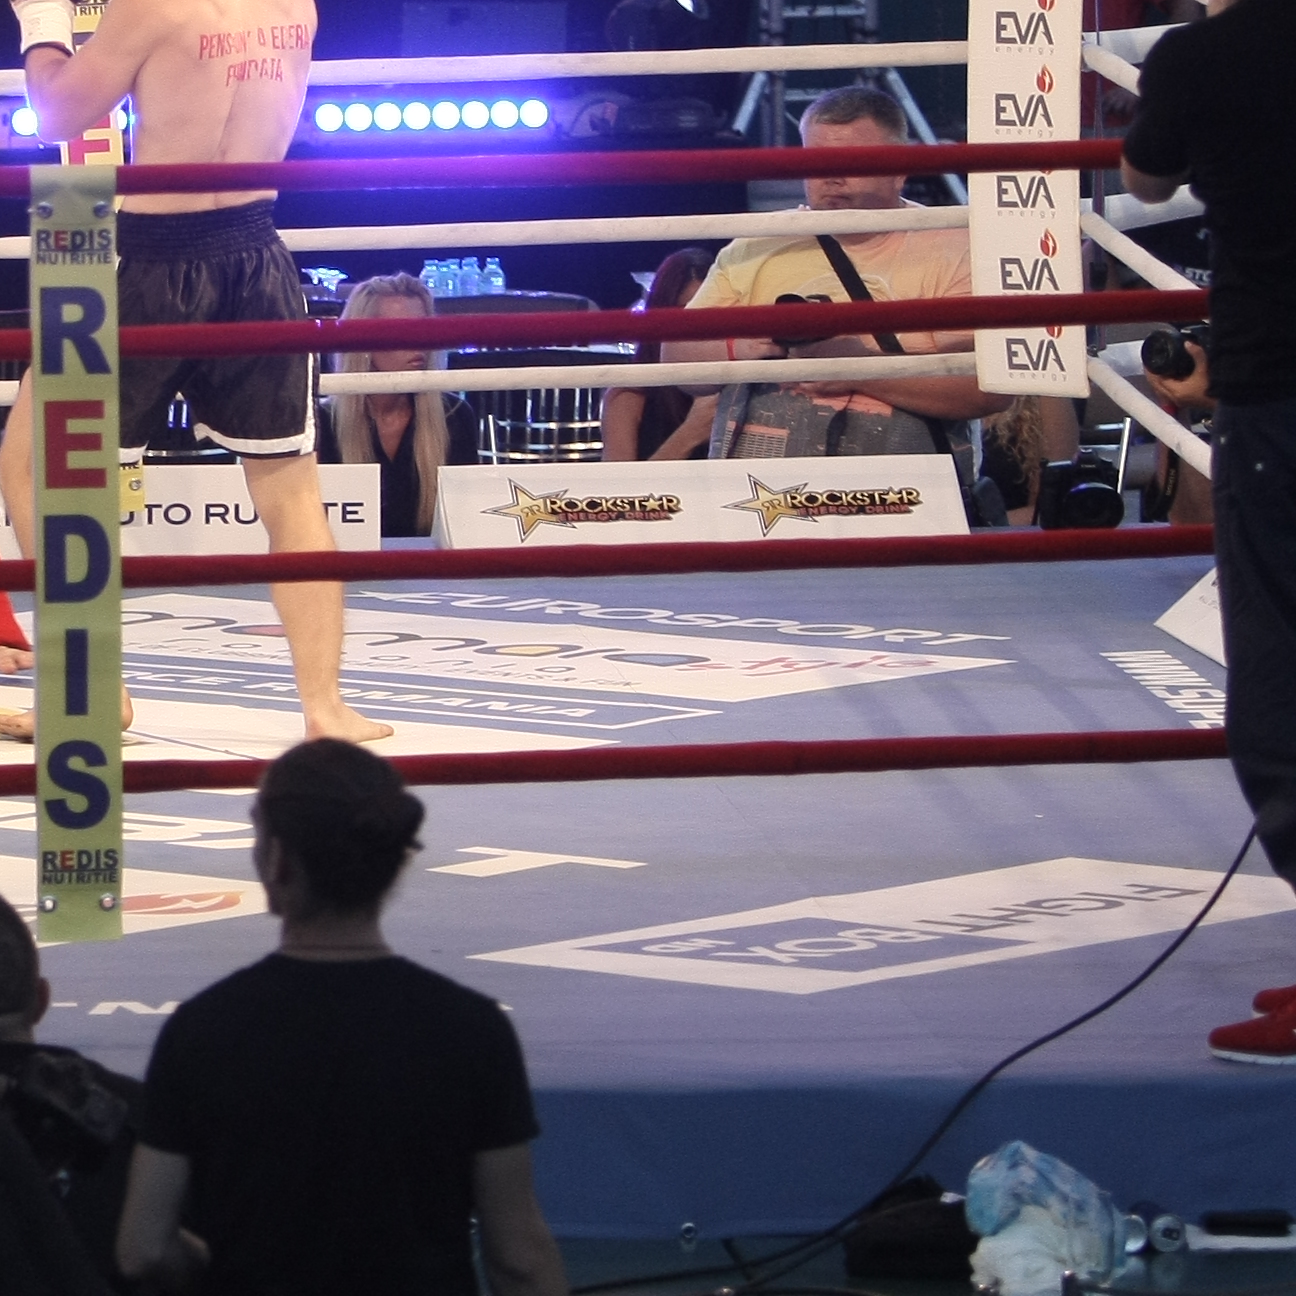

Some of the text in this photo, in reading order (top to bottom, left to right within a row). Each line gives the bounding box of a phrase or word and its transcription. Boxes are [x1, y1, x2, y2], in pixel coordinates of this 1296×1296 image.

[995, 11, 1054, 45] EVA
[994, 46, 1055, 55] energy
[994, 93, 1053, 127] EVA
[994, 128, 1054, 137] energy
[996, 175, 1055, 208] EVA
[997, 210, 1056, 219] energy
[36, 228, 112, 251] REDIS
[36, 251, 112, 265] NUTRITIE
[1000, 258, 1060, 291] EVA
[1005, 338, 1066, 371] EVA
[1008, 372, 1068, 382] energy
[546, 494, 681, 512] ROCKSTAR
[786, 488, 920, 507] ROCKSTAR
[558, 510, 670, 521] ENERGY DRINK
[798, 504, 910, 516] ENERGY DRINK
[40, 285, 112, 830] REDIS
[353, 590, 1012, 646] EUROSPORT
[241, 680, 596, 718] RMANIA
[42, 848, 118, 870] REDIS
[42, 870, 118, 885] NUTRITIE
[914, 881, 1209, 934] FIGHT
